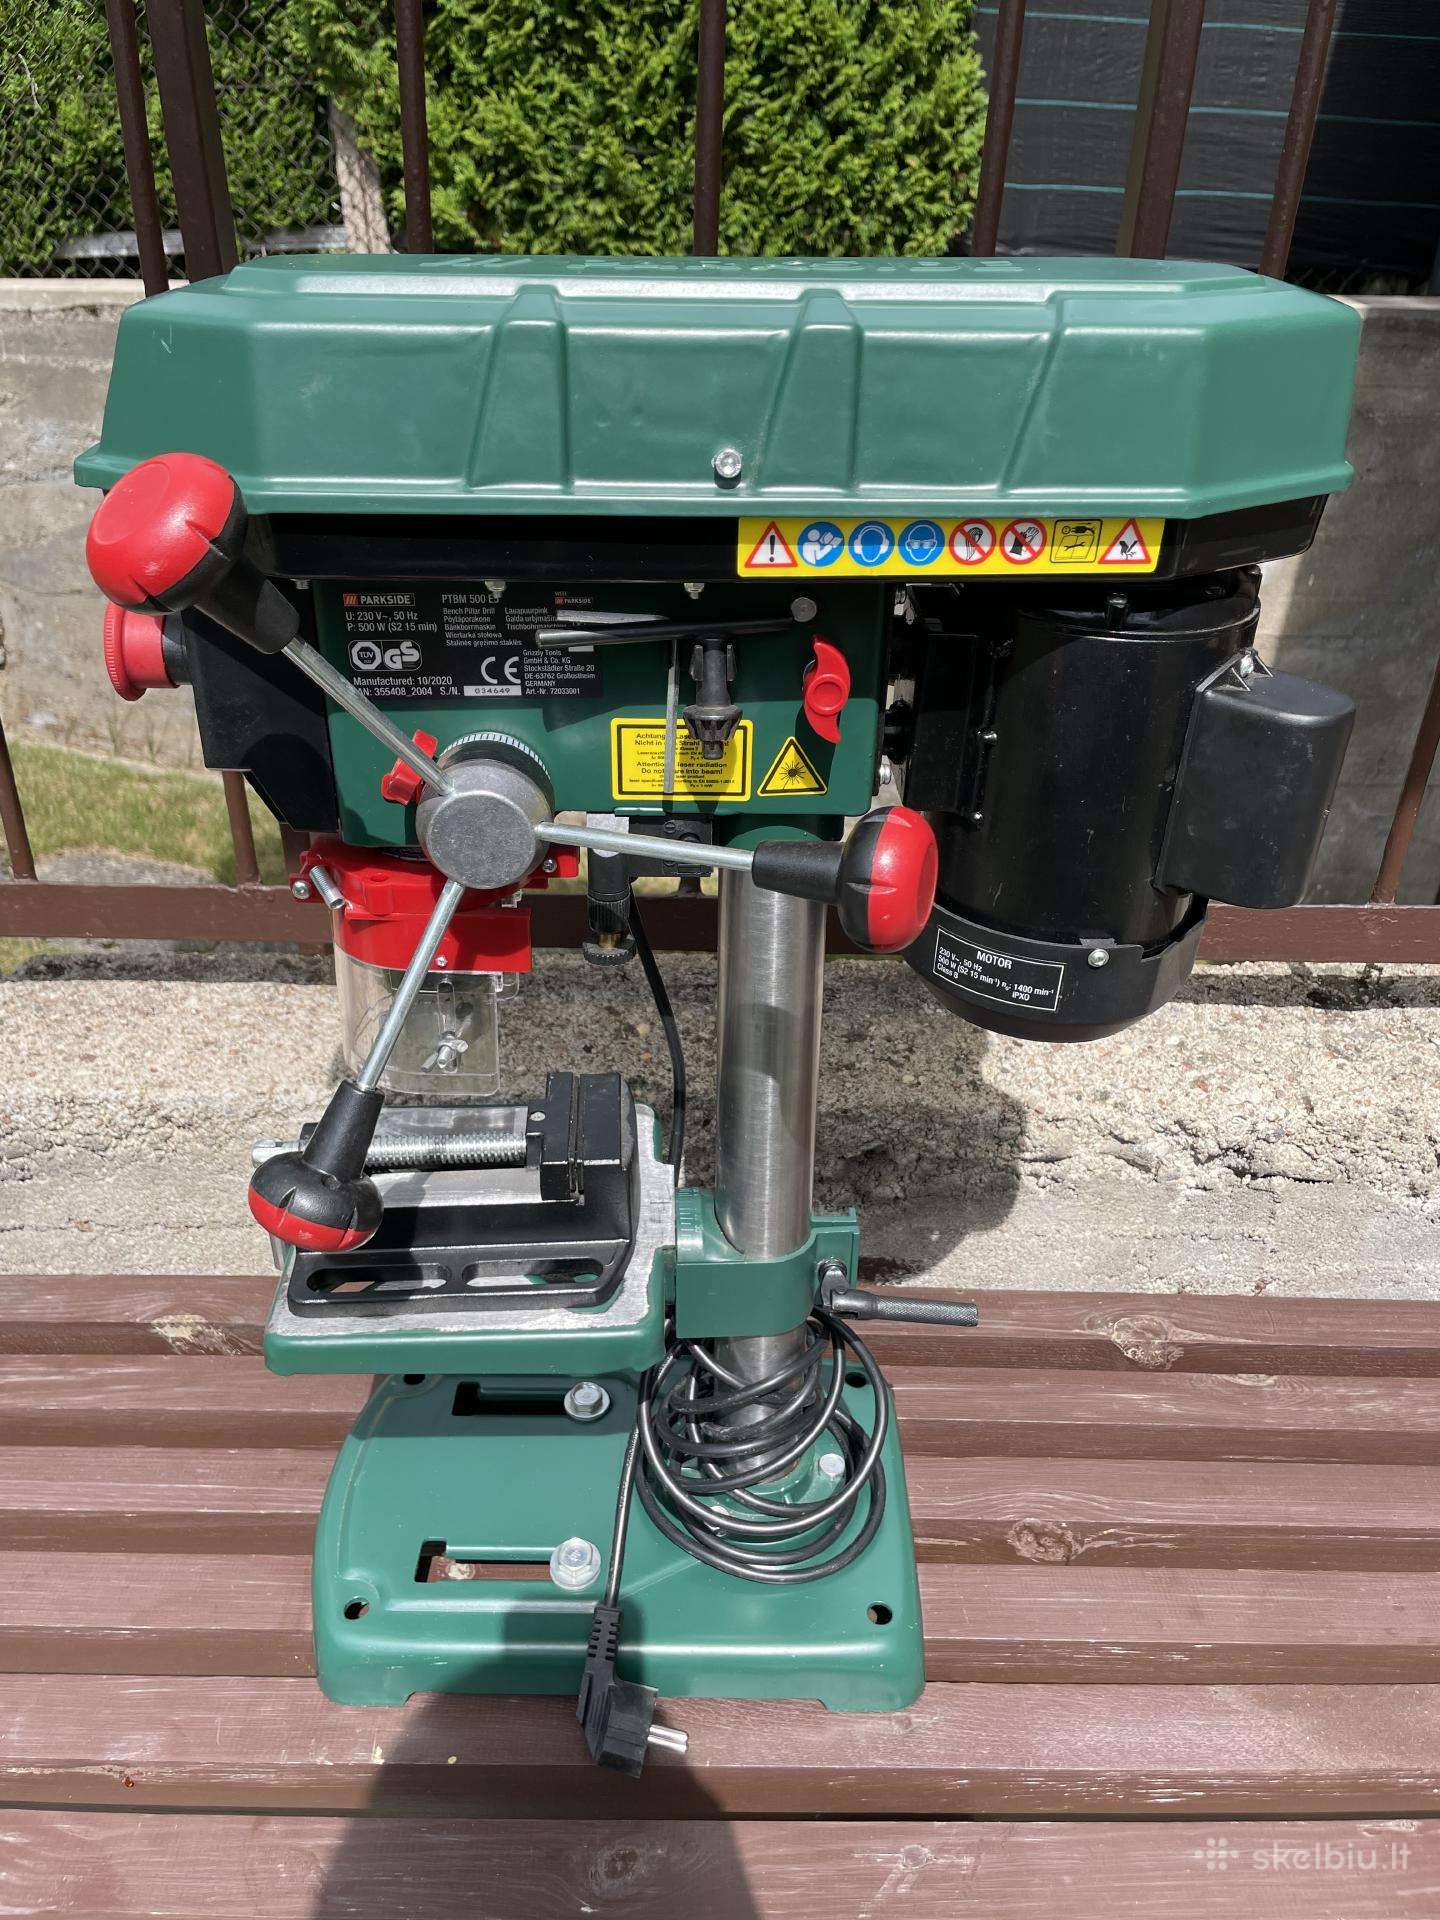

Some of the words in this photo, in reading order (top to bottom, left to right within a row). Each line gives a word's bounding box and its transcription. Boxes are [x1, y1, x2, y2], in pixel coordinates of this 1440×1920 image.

[360, 595, 411, 605] PARKSIDE
[442, 594, 467, 604] PTBM
[469, 594, 486, 604] 500
[345, 611, 355, 620] U:
[357, 611, 374, 620] 230
[393, 611, 405, 620] 50
[406, 611, 419, 620] Hz
[443, 607, 464, 615] Bench
[464, 607, 480, 615] Pillar
[482, 607, 495, 615] Drill
[347, 622, 357, 632] P:
[358, 622, 375, 632] 500
[376, 622, 386, 632] W
[388, 622, 402, 633] (S2
[404, 622, 416, 631] 15
[418, 622, 438, 633] min)
[384, 641, 420, 670] GS
[523, 649, 543, 657] Grizzly
[480, 656, 522, 684] CE
[524, 664, 563, 672] Stockstädter
[586, 664, 595, 672] 20
[353, 676, 415, 686] Manufactured:
[416, 676, 453, 686] 10/2020
[524, 672, 556, 680] DE-63762
[373, 686, 433, 698] 355408_2004
[550, 687, 580, 695] 72033001
[939, 946, 951, 958] 230
[963, 959, 973, 968] 50
[973, 964, 983, 972] Hz
[976, 950, 1013, 970] MOTOR
[937, 962, 953, 976] Class
[938, 955, 951, 966] 500
[950, 961, 957, 970] W
[957, 964, 969, 975] (S2
[970, 970, 979, 979] 15
[1013, 983, 1033, 994] 1400
